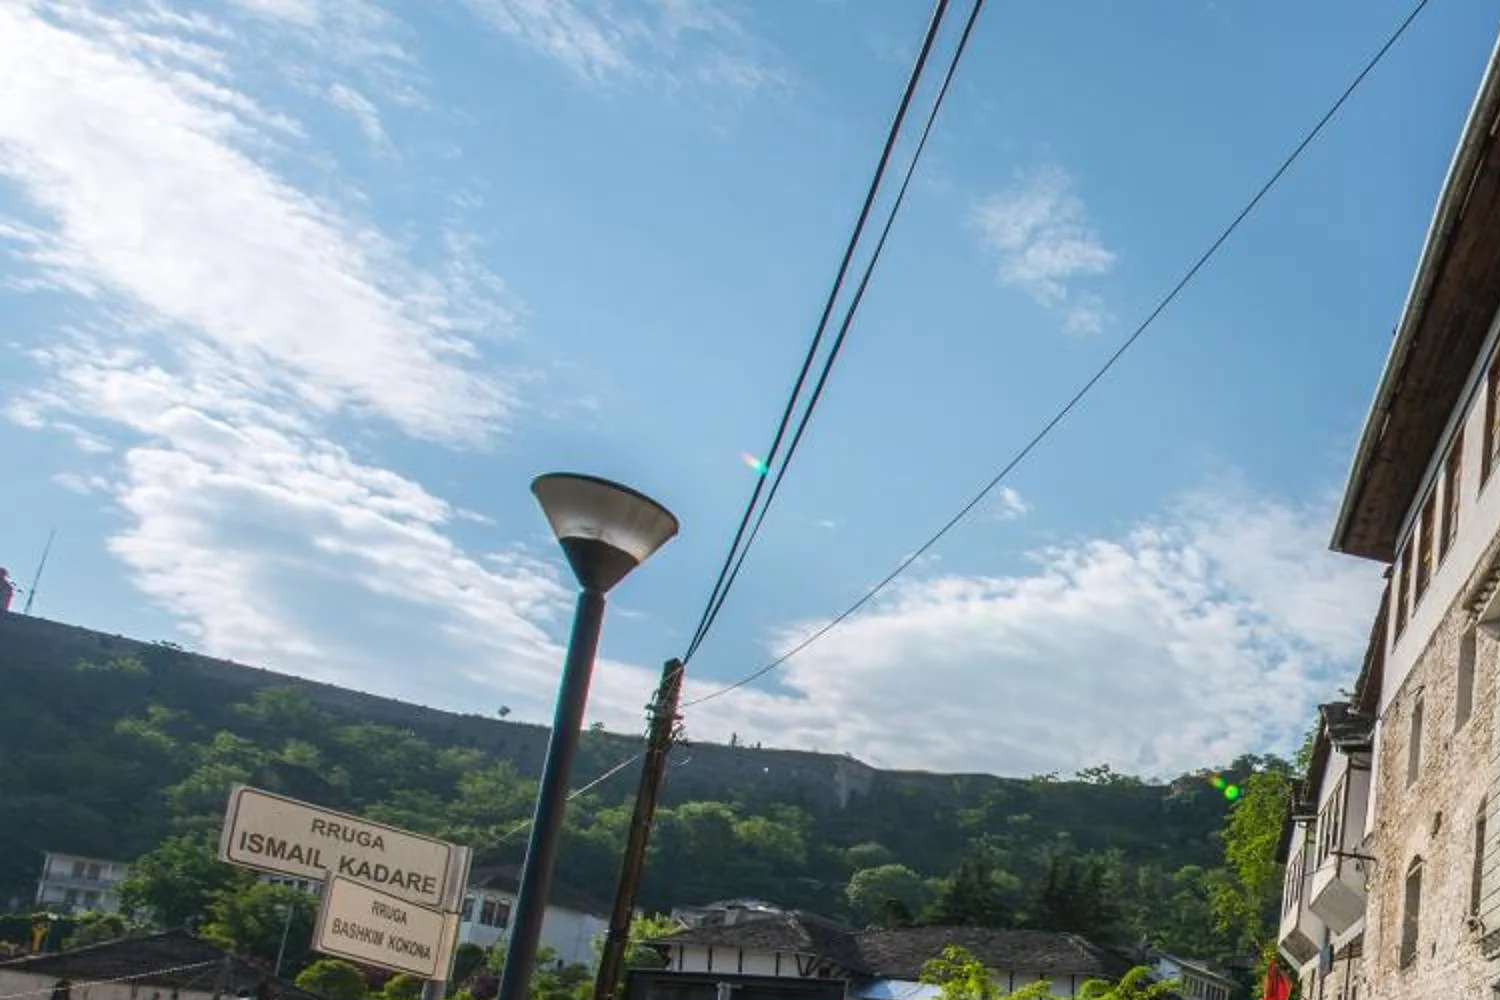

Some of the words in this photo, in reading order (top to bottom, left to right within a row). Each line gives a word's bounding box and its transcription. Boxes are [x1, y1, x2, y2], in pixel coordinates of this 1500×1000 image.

[311, 818, 386, 851] RRUGA
[239, 831, 327, 869] ISMAIL
[338, 855, 437, 895] KADARE
[371, 900, 407, 925] RRUGA
[331, 917, 385, 945] BASHKIM
[387, 934, 431, 960] KOKONA
